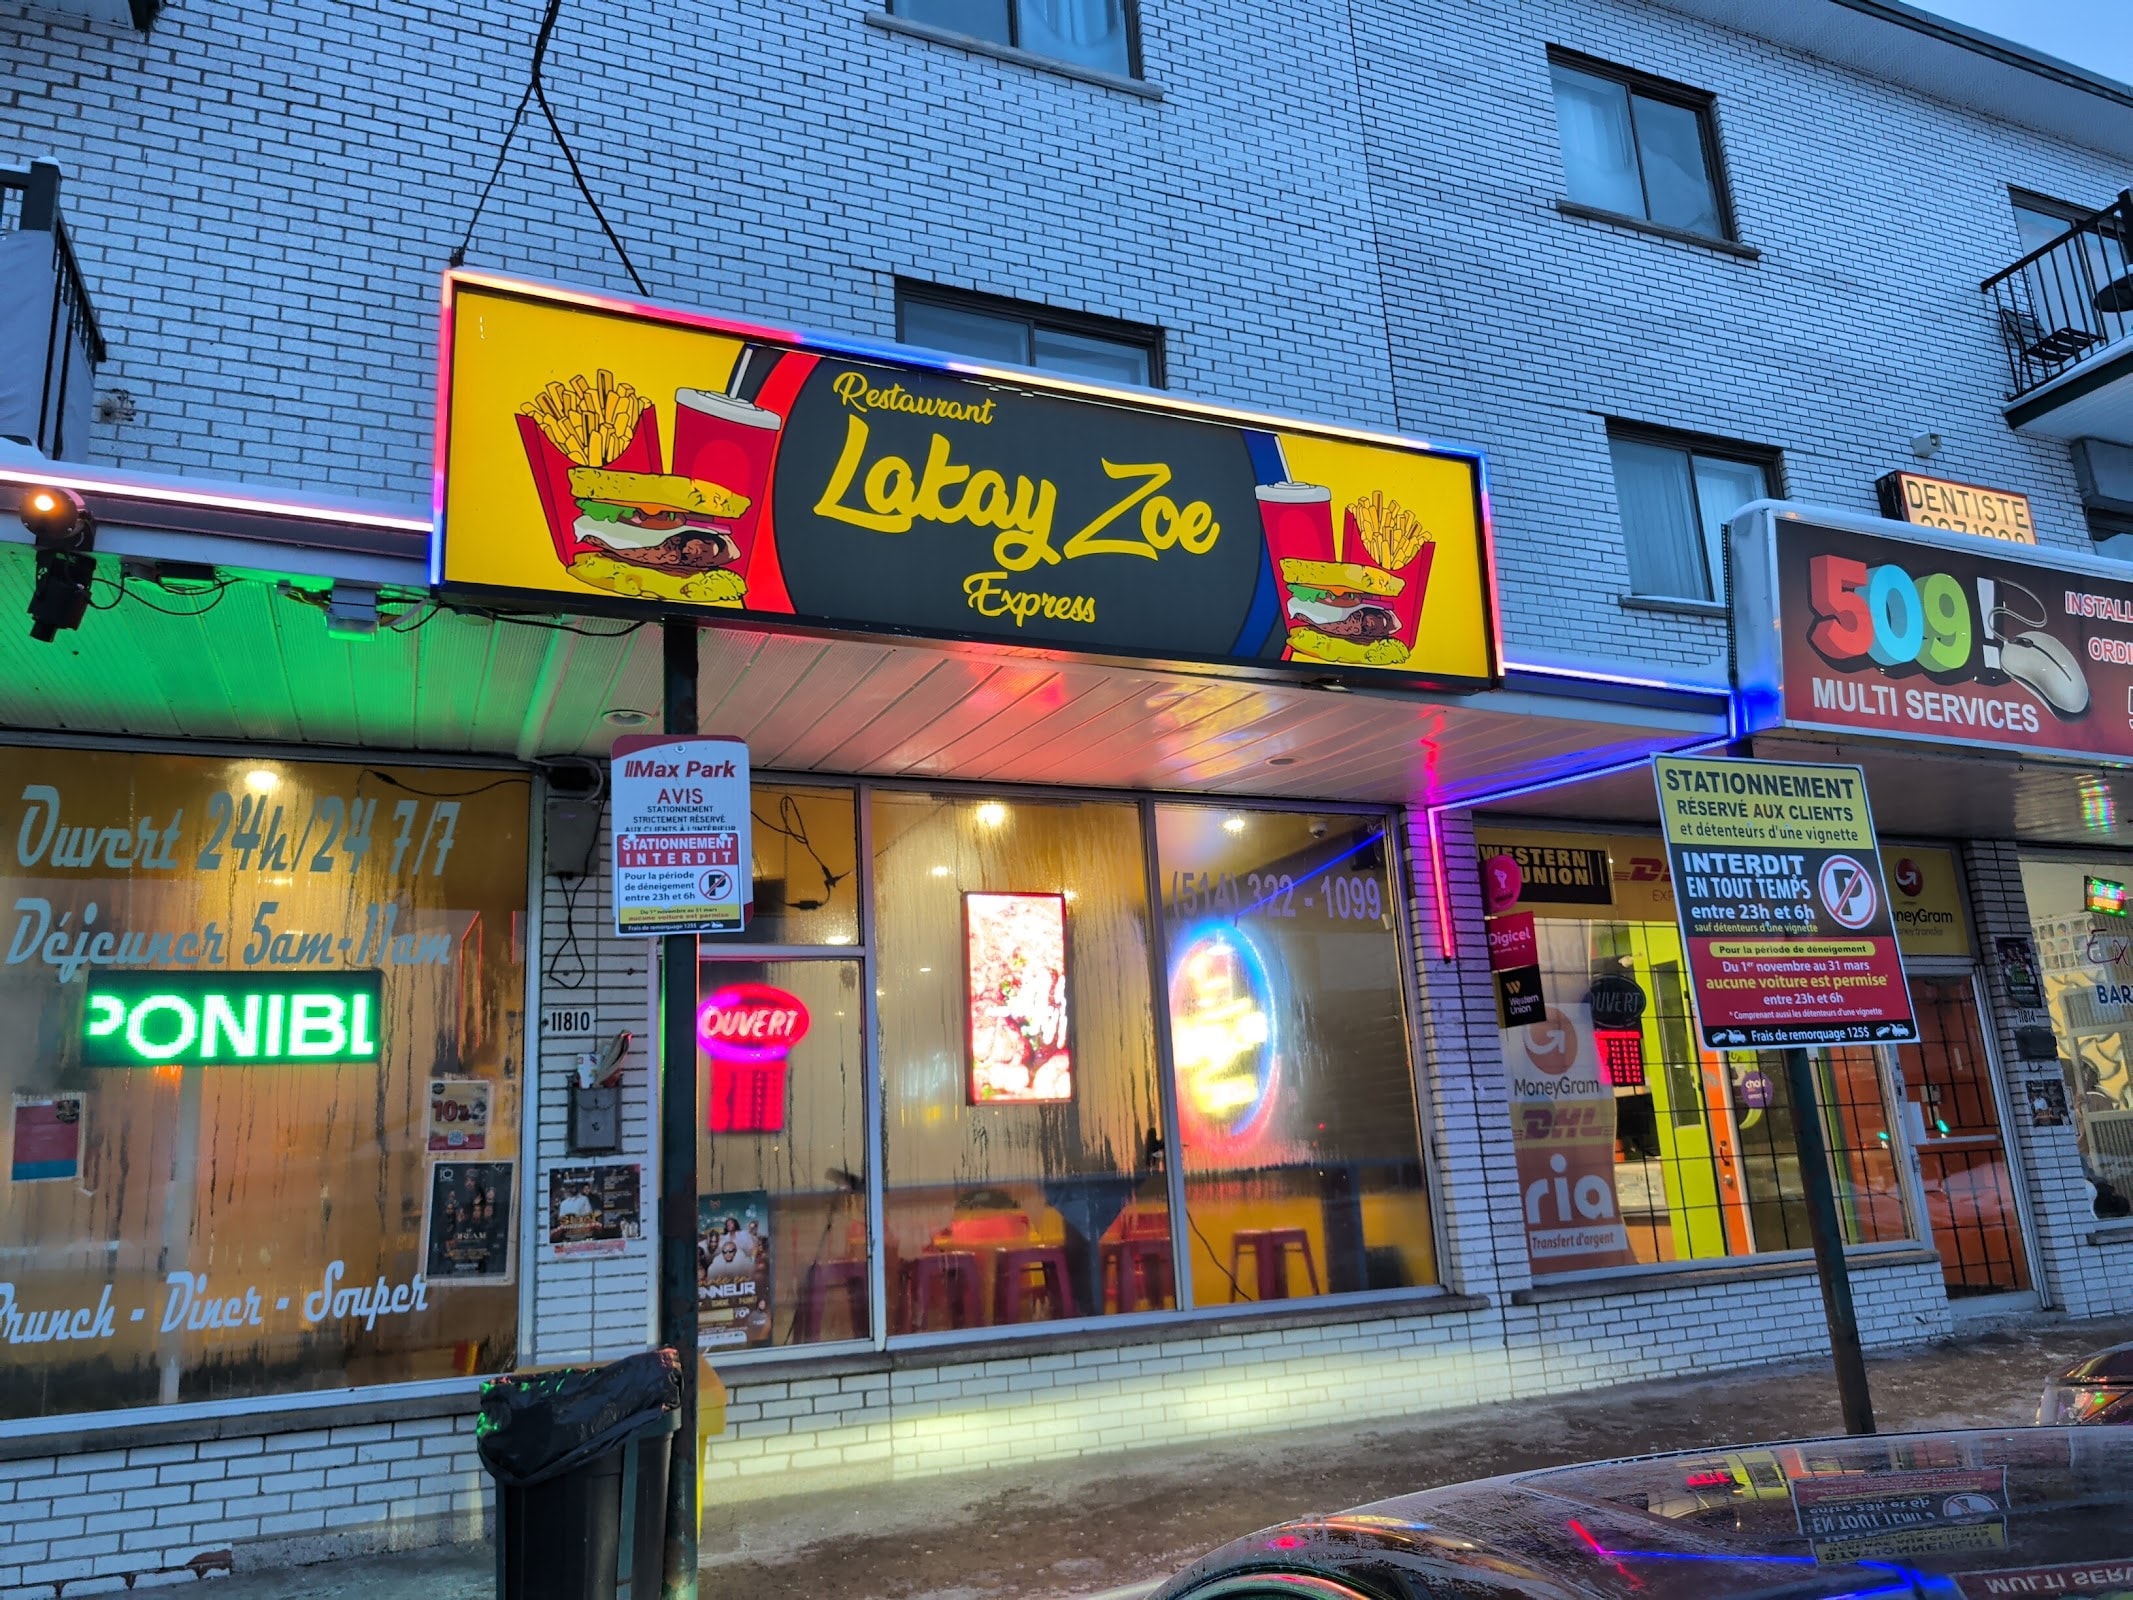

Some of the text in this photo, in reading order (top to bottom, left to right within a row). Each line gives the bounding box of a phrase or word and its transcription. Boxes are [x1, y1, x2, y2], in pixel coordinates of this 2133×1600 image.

[833, 371, 996, 425] Restaurant
[813, 414, 1220, 572] Lakay Zoe
[1905, 480, 2030, 529] DENTISTE
[963, 571, 1096, 627] Express
[1812, 677, 2040, 733] MULTI SERVICES
[686, 760, 736, 778] Park
[1665, 769, 1854, 799] STATIONNEMENT
[657, 788, 703, 804] AVIS
[633, 814, 726, 824] STRICTEMENT RÉSERVÉ
[1677, 796, 1854, 822] RÉSERVÉ AUX CLIENTS
[16, 784, 462, 877] Ouvert 24h/24 7/7
[1680, 822, 1858, 843] et détenteurs d'une vignette
[622, 837, 734, 850] STATIONNEMENT
[625, 851, 731, 865] INTERDIT
[1682, 851, 1804, 876] INTERDIT
[625, 871, 694, 881] Pour la période
[1521, 865, 1589, 886] UNION
[625, 882, 694, 891] de déneigement
[652, 893, 670, 901] 23h
[684, 892, 695, 900] 6h
[1172, 871, 1239, 918] (514)
[1247, 873, 1296, 917] 322
[1320, 876, 1383, 920] 1099
[1687, 877, 1811, 900] EN TOUT TEMPS
[1691, 904, 1815, 920] entre 23h et 6h
[1892, 908, 1953, 926] neyGram
[1488, 926, 1532, 946] Digicel
[1694, 922, 1818, 934] sauf détenteurs d'une vignette
[5, 897, 227, 984] Déjeuner
[1719, 944, 1866, 955] Pour la période de déneigement
[1723, 961, 1739, 973] Du
[1756, 960, 1810, 972] novembre
[1813, 962, 1827, 972] au
[1828, 960, 1841, 971] 31
[1844, 961, 1870, 971] mars
[1706, 977, 1756, 989] aucune
[1758, 975, 1807, 988] voiture
[1810, 975, 1830, 988] est
[1509, 993, 1540, 1005] Western
[1763, 993, 1843, 1006] entre 23h et 6h
[2096, 984, 2133, 1005] BAR
[1510, 1003, 1532, 1015] Union
[1734, 1007, 1883, 1020] Comprenant aussi les détenteurs d'une vignette
[552, 1011, 590, 1031] 11810
[705, 1007, 799, 1039] OUVERT
[1751, 1026, 1870, 1042] Frais de remorquage 125$
[1514, 1077, 1600, 1099] MoneyGram
[1522, 1107, 1597, 1140] DHL
[1525, 1153, 1614, 1225] ria
[1532, 1231, 1614, 1250] Transfert d'argent
[160, 1270, 262, 1334] Diner
[303, 1260, 429, 1331] Souper
[698, 1281, 756, 1299] NNEUR
